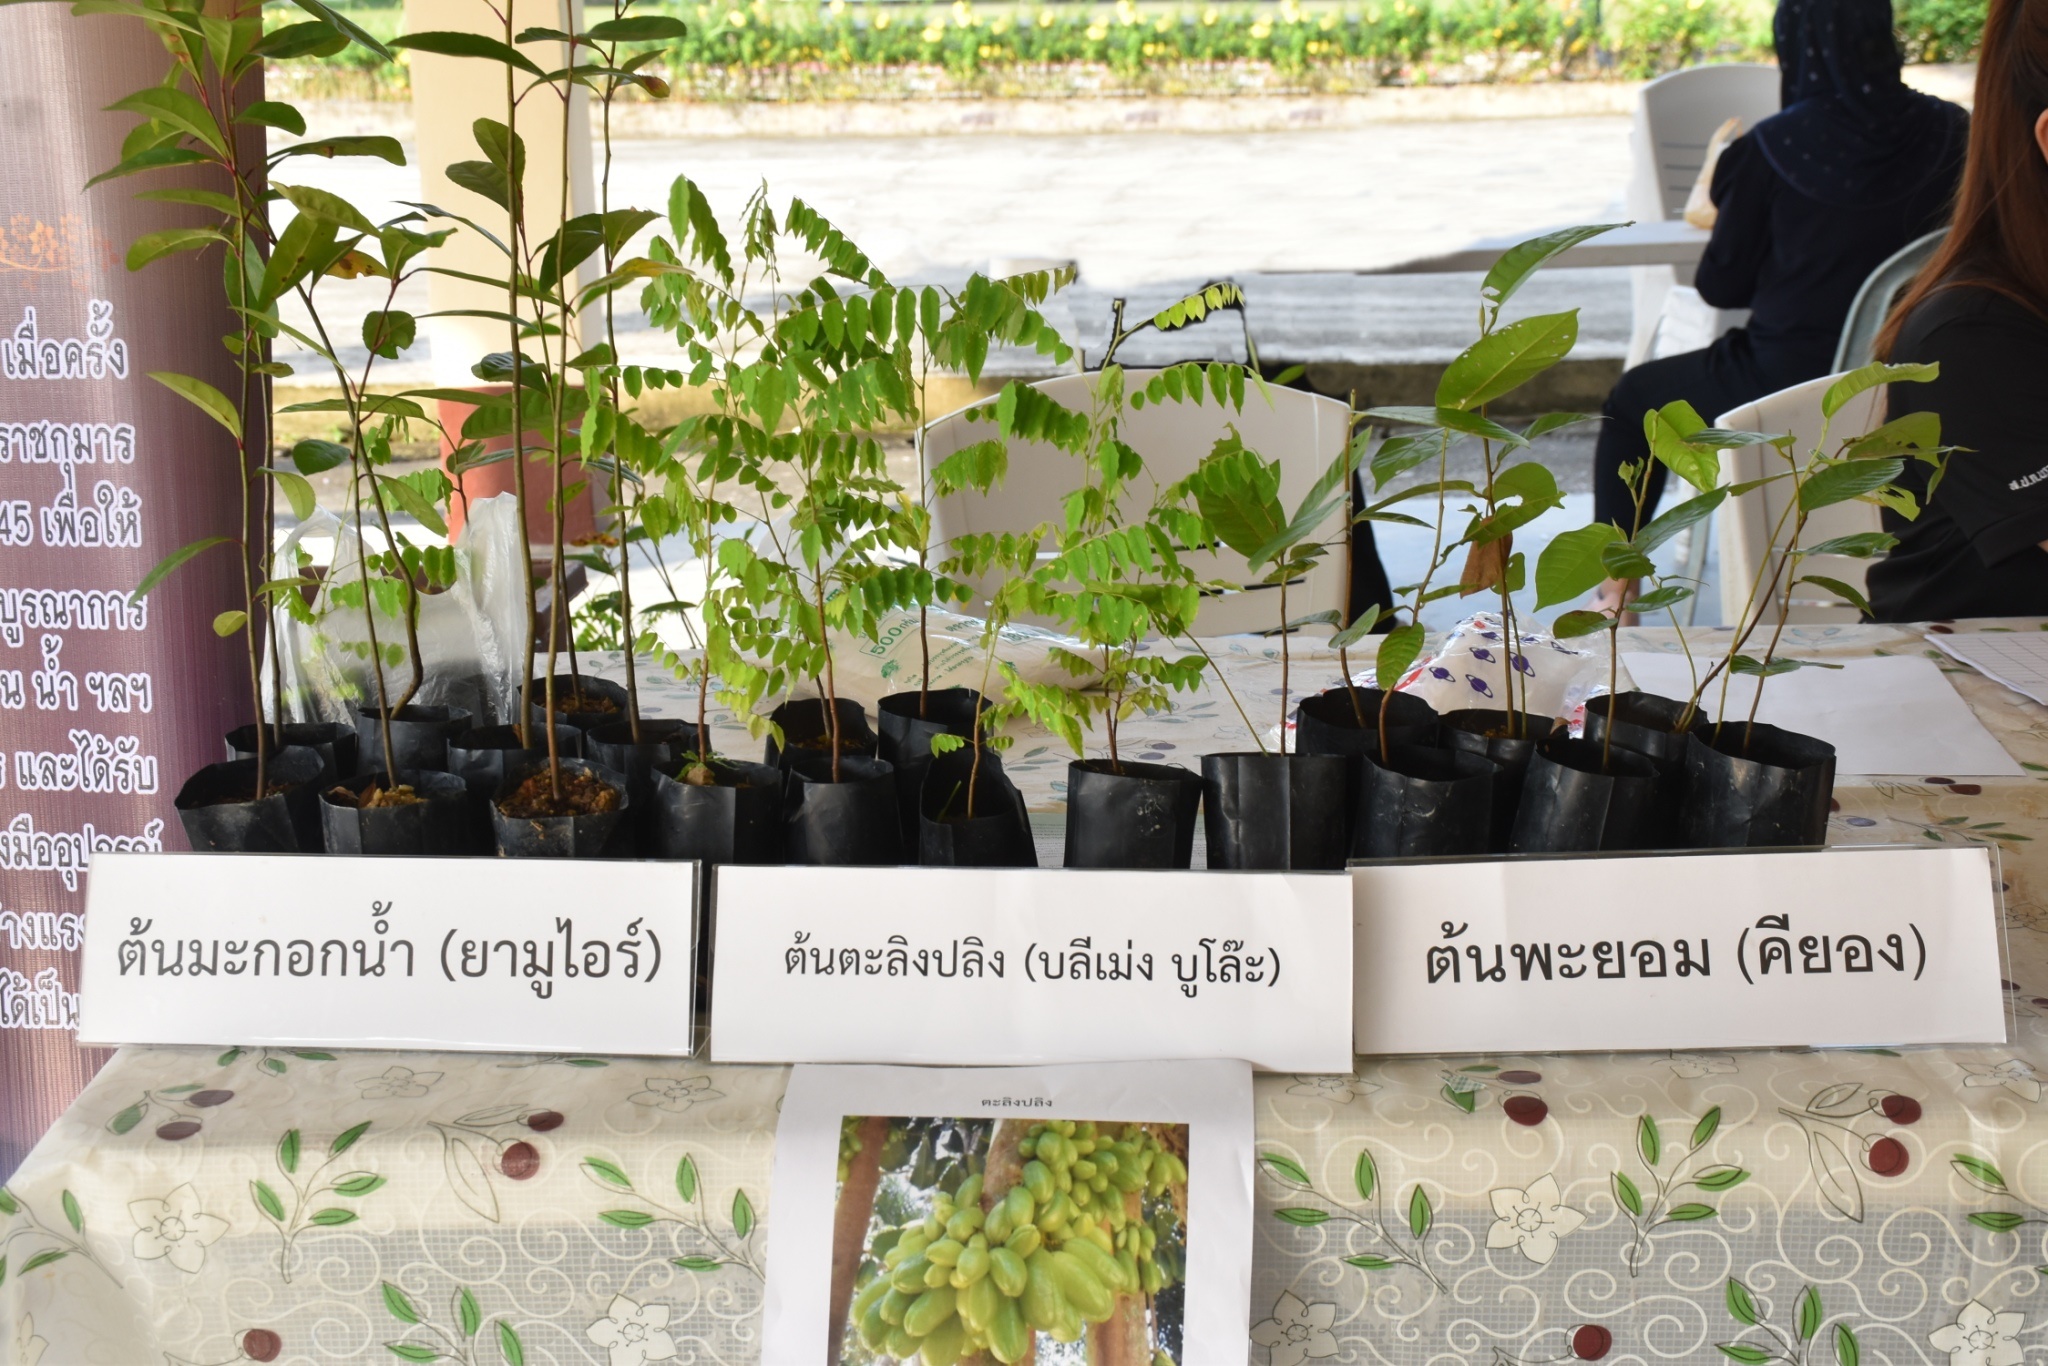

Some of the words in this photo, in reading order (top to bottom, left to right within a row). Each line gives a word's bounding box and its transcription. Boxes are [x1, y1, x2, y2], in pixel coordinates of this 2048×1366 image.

[2, 300, 128, 378] เมื่อครั้ง
[42, 481, 141, 546] เพื่อให้
[34, 635, 77, 710] น้ำ
[87, 673, 150, 712] ฯลฯ
[17, 730, 156, 793] และได้รับ
[119, 901, 413, 977] ต้นมะกอกน้ำ
[441, 917, 662, 999] (ยามูไอร์)
[785, 931, 1005, 979] ต้นตะลิงปลิง
[1025, 937, 1153, 982] (บลีเม่ง
[1171, 938, 1281, 998] บูโล๊ะ)
[1426, 921, 1711, 984] ต้นพะยอม
[1737, 913, 1926, 985] (คียอง)
[981, 1097, 1053, 1107] ตะลิงปลิง
